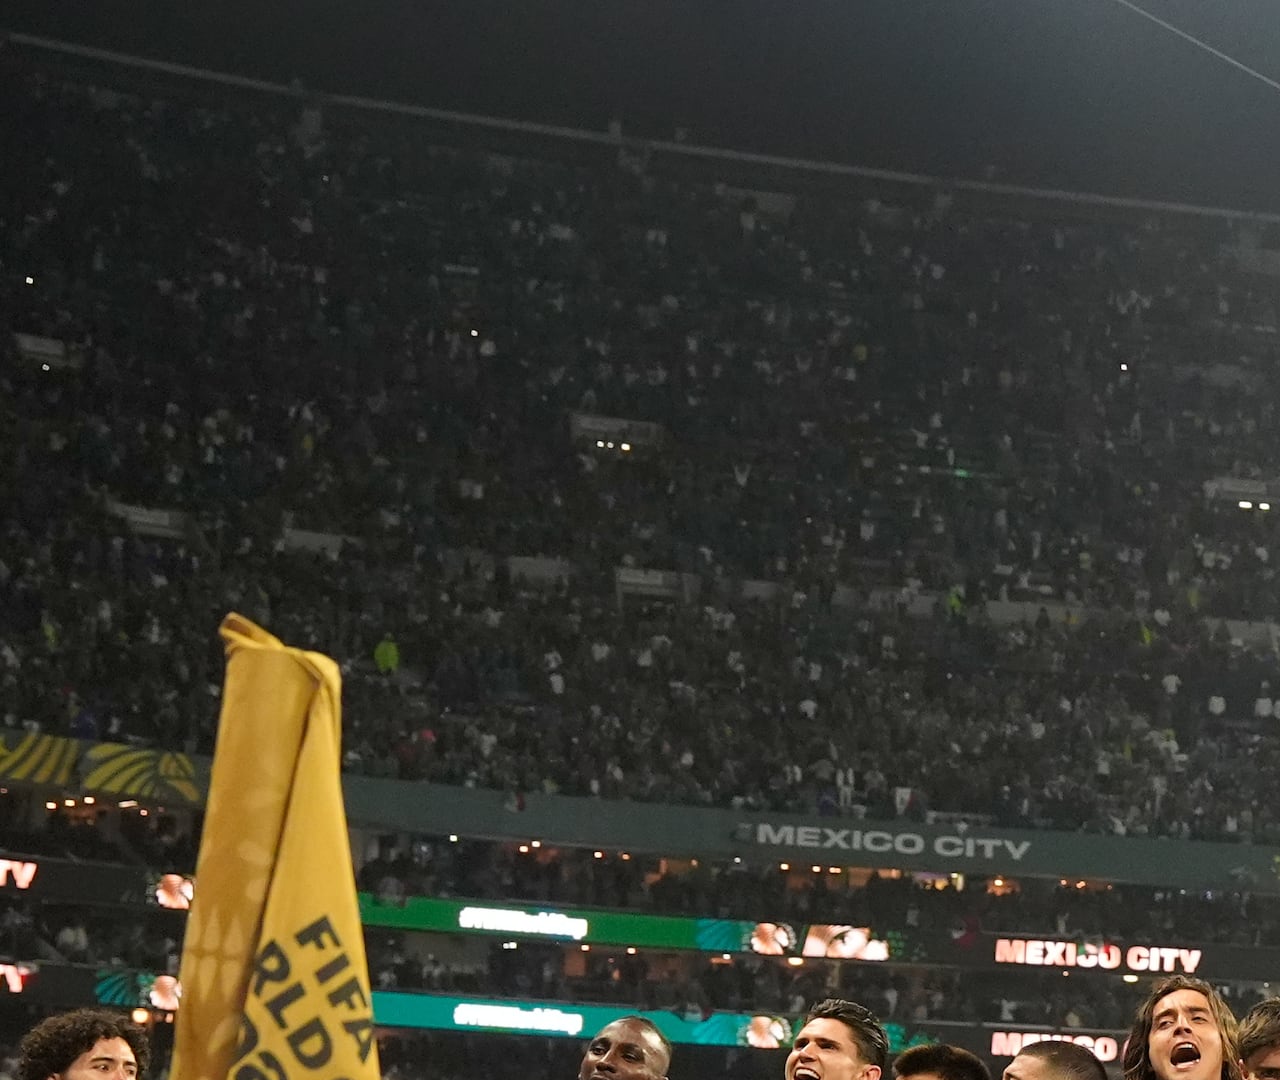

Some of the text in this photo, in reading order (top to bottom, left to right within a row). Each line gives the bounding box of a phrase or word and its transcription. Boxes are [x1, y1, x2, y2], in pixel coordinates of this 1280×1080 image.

[757, 823, 1031, 860] MEXICO CITY
[294, 914, 373, 1064] FIFA
[1126, 946, 1201, 973] CITY
[252, 939, 335, 1071] RLD
